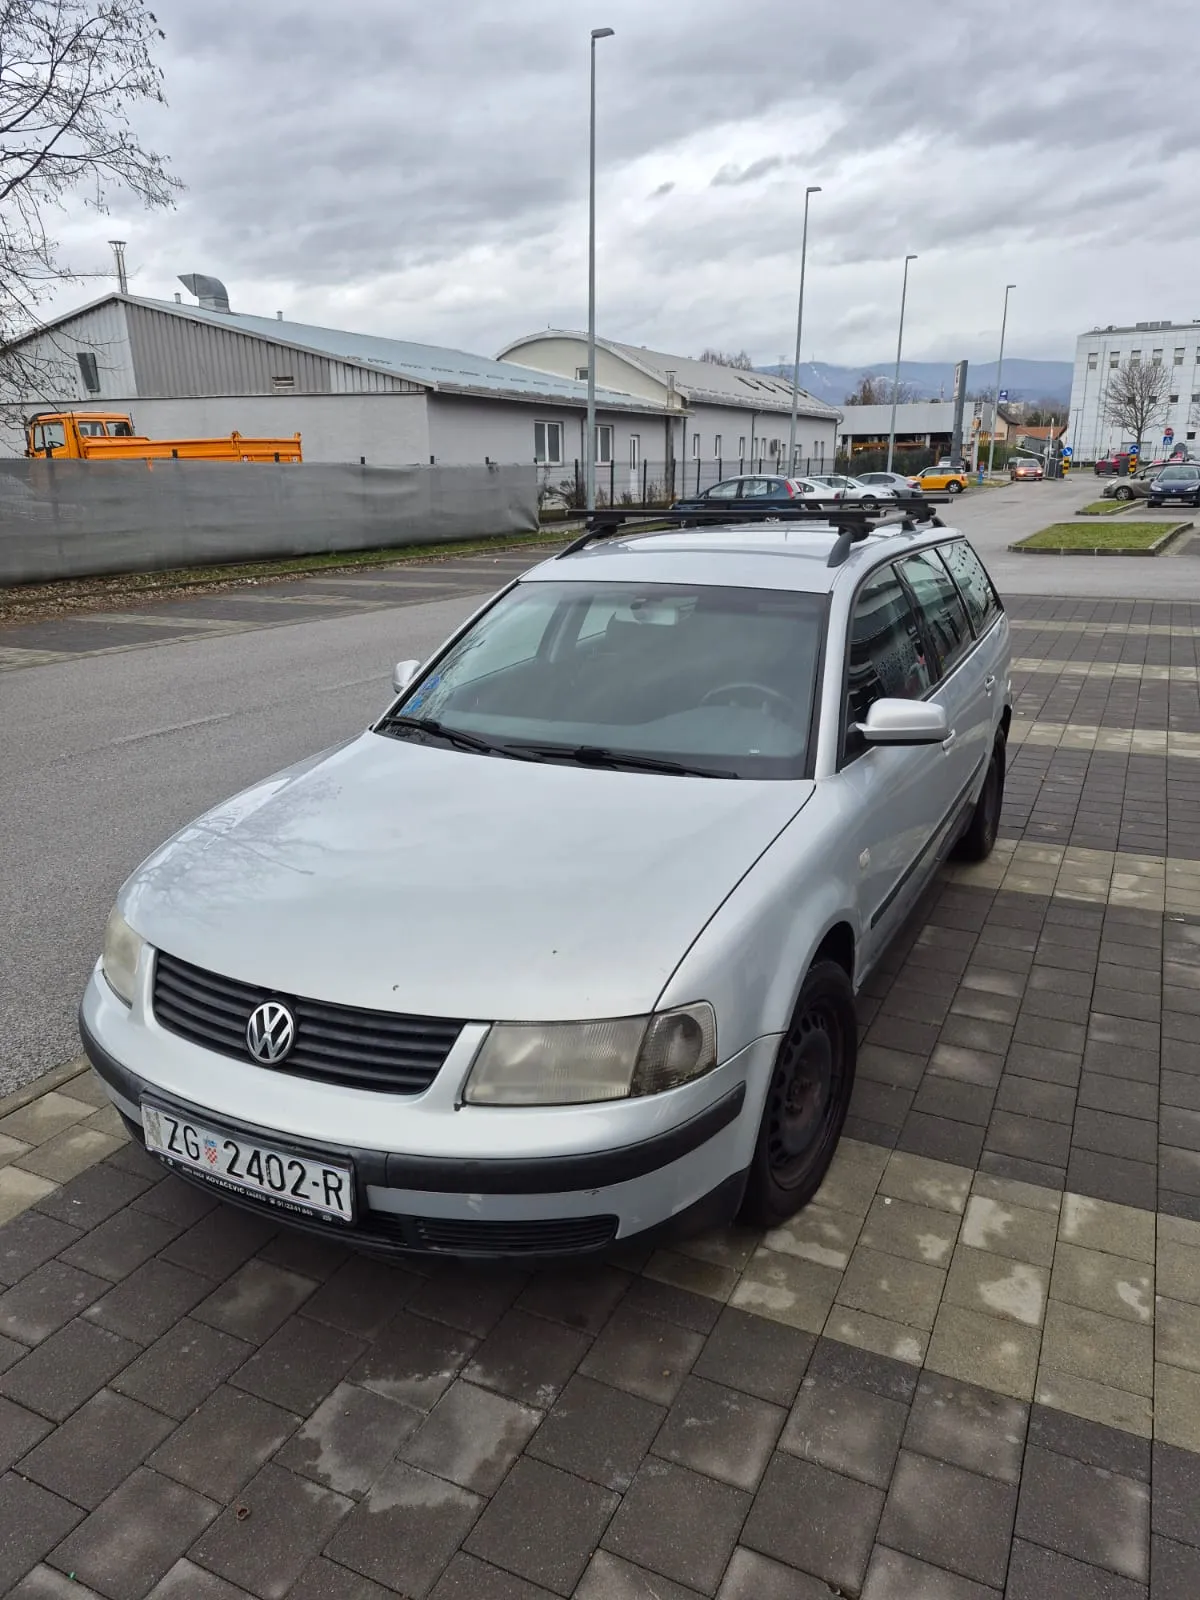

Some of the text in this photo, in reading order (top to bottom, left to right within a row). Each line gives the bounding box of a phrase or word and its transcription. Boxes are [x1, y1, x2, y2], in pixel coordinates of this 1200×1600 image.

[247, 1002, 294, 1064] VW
[164, 1116, 344, 1211] ZG 2402-R
